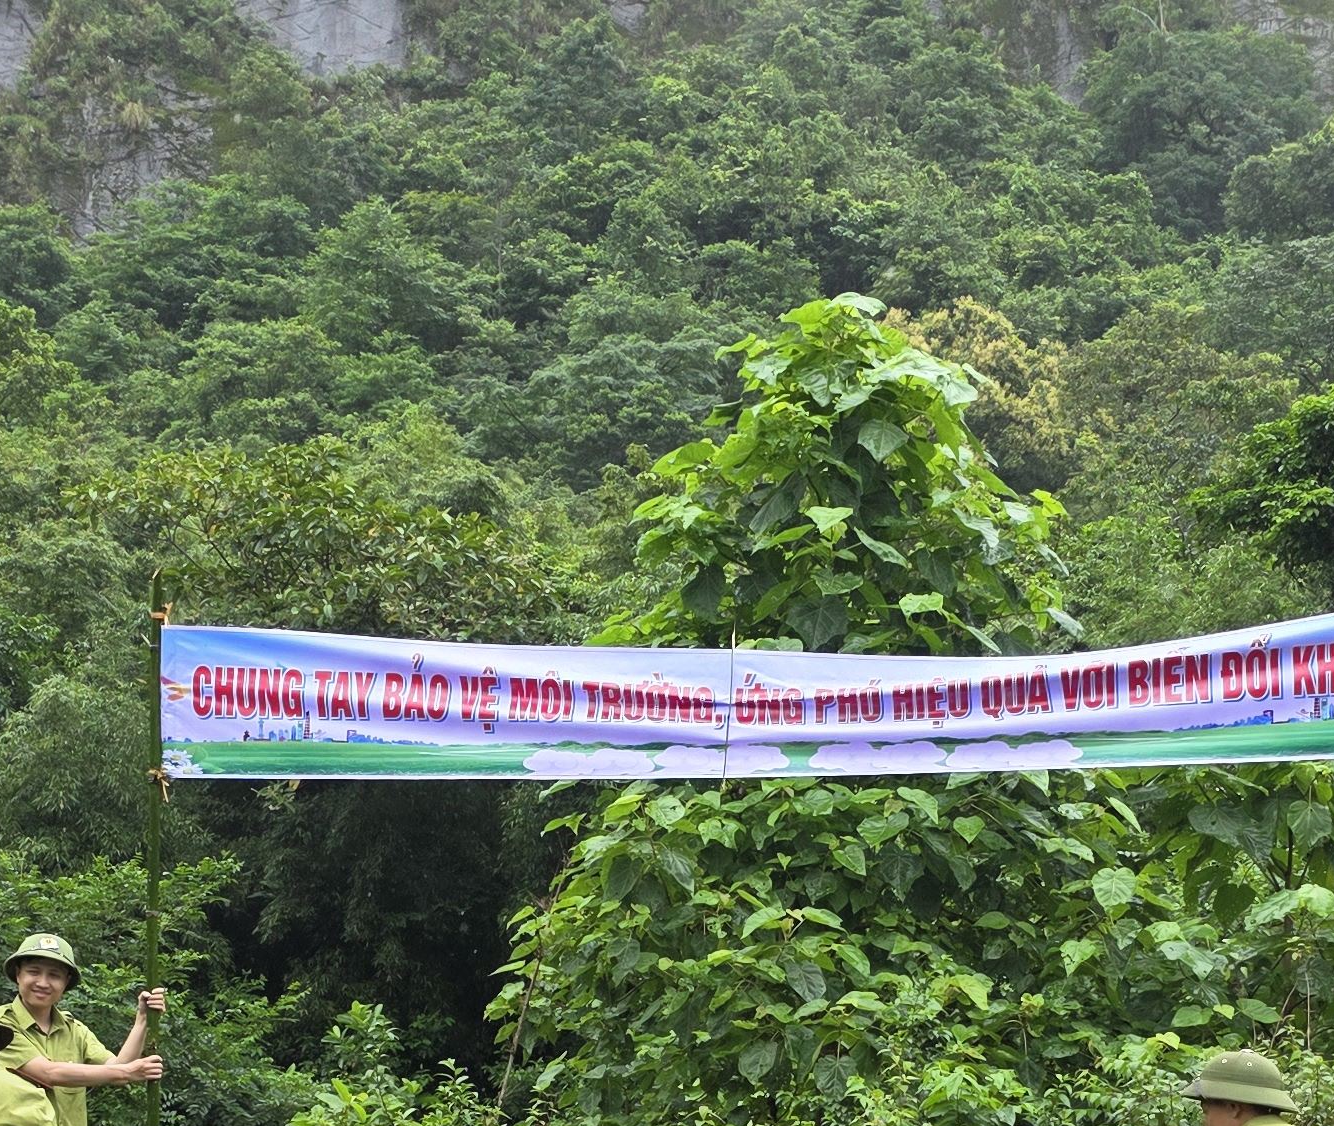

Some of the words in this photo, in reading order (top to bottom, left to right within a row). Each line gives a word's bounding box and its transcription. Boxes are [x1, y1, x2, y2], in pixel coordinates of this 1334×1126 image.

[192, 664, 305, 719] CHUNG
[313, 669, 378, 720] TAY
[383, 653, 451, 722] BẢO
[459, 666, 500, 733] VỆ
[508, 670, 575, 722] MÔI
[581, 672, 728, 729] TRƯỜNG,
[734, 673, 805, 726] ỨNG
[814, 679, 885, 724] PHÓ
[892, 676, 972, 728] HIỆU
[980, 664, 1053, 720] QUẢ
[1060, 660, 1120, 711] VỚI
[1128, 646, 1214, 707] BIẾN
[1221, 633, 1284, 702] ĐỔI
